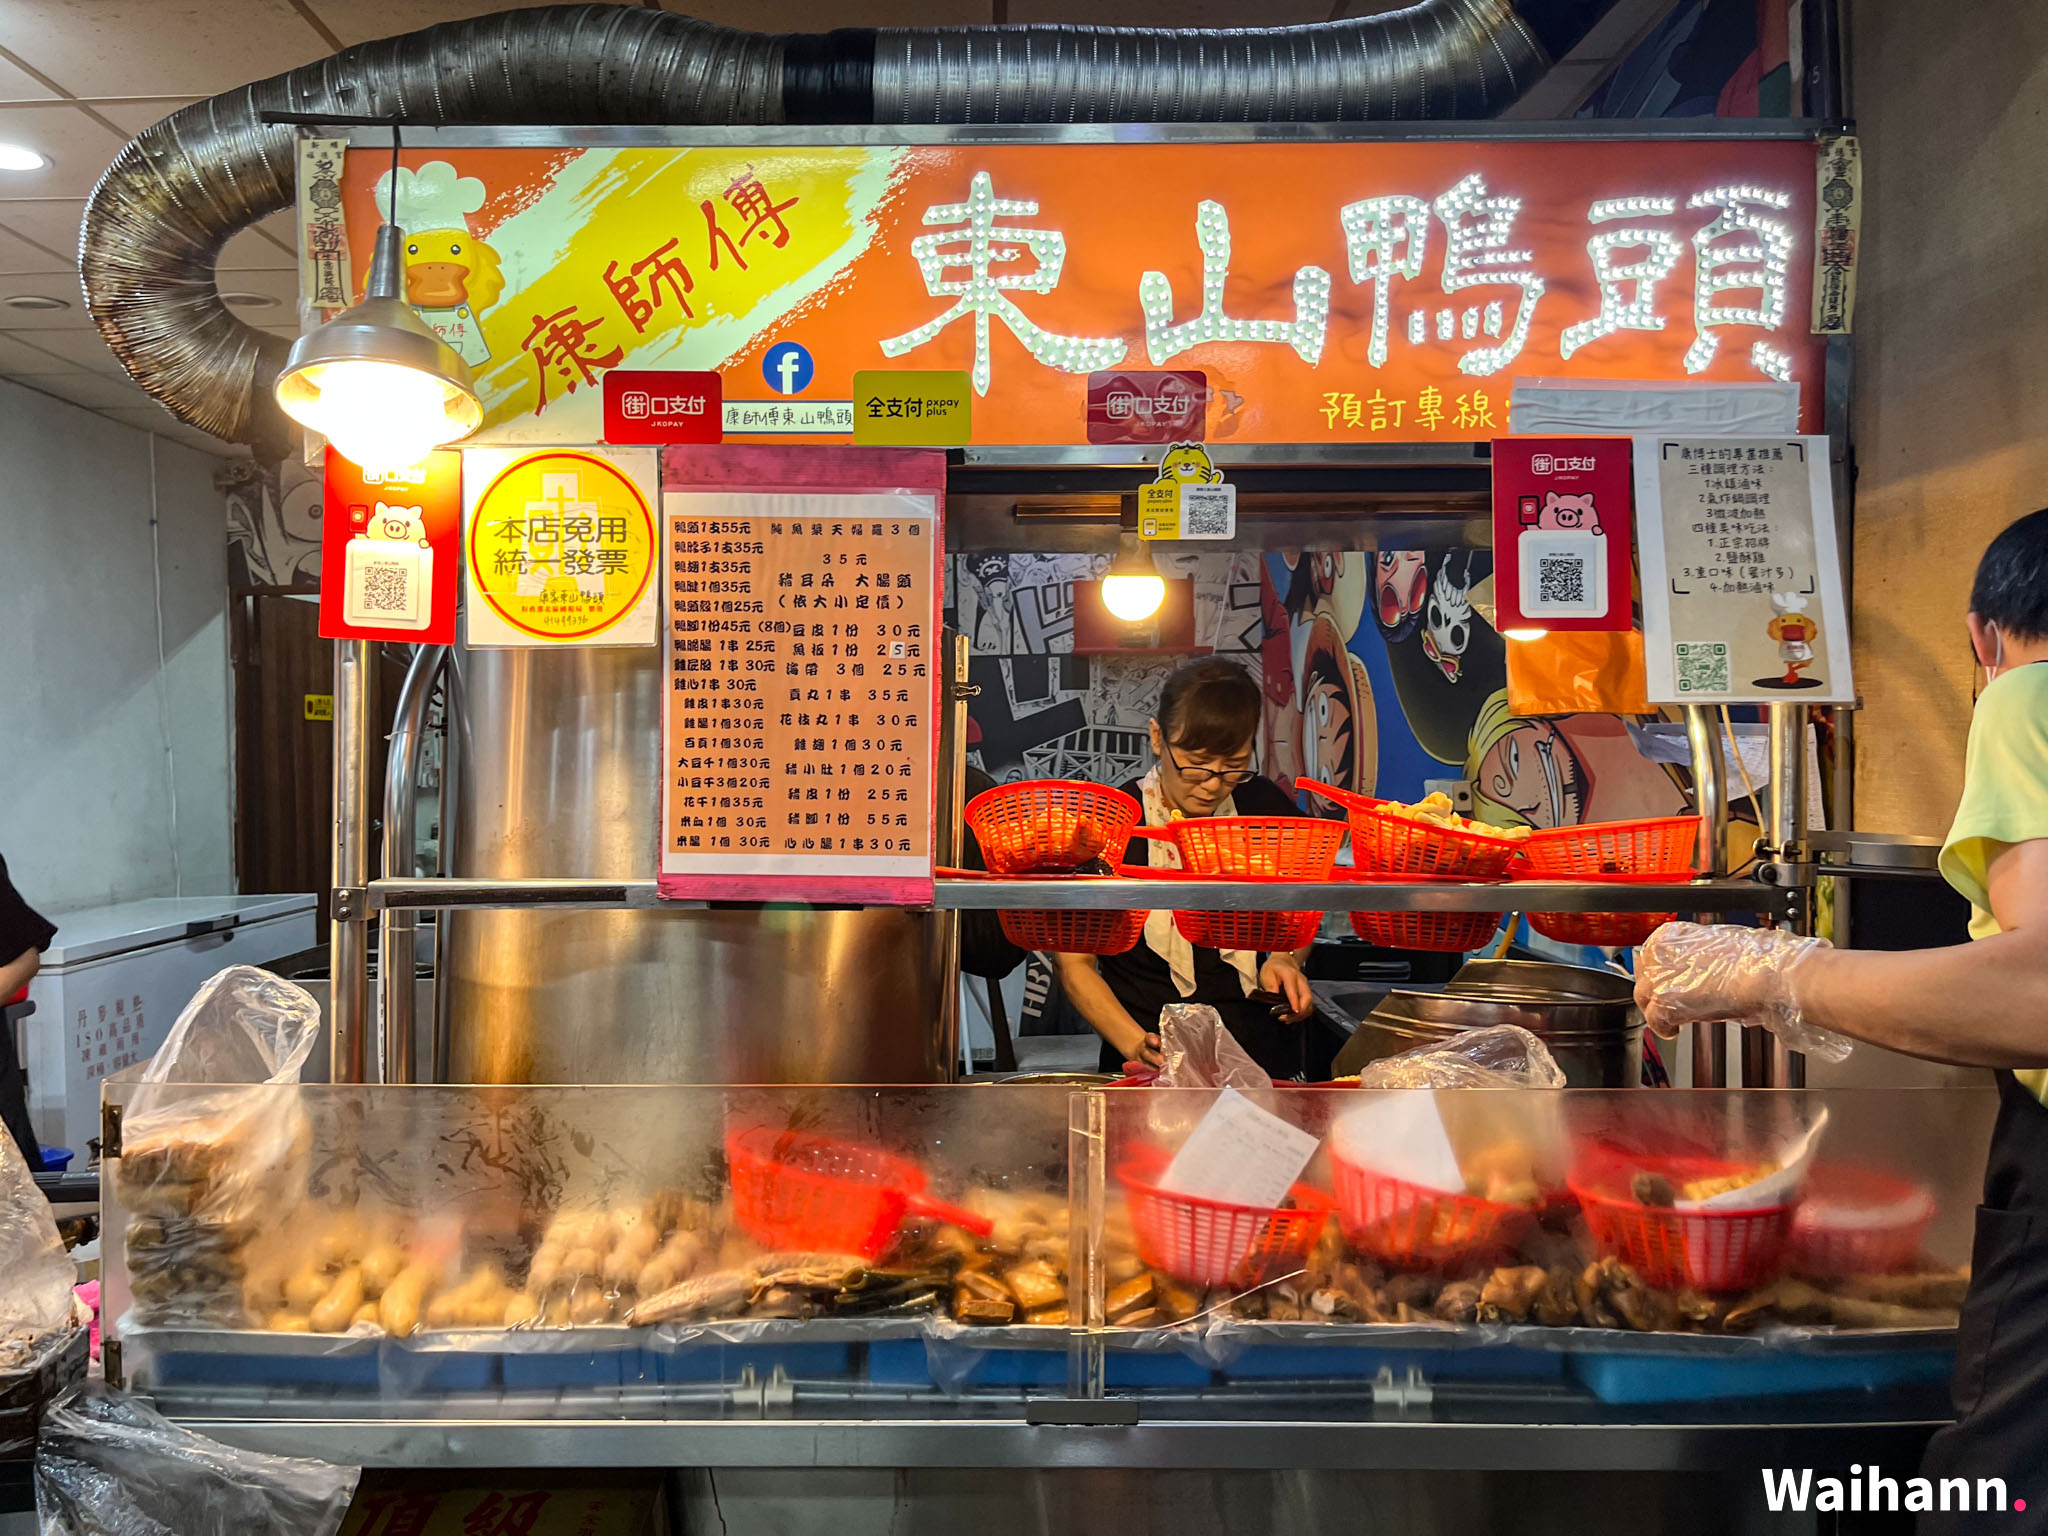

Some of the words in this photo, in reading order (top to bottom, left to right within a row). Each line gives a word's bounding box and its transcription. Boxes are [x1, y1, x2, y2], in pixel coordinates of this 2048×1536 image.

[521, 165, 800, 416] 康師傅
[879, 170, 1792, 398] 東山鴨頭
[622, 391, 706, 419] 街口支付
[865, 396, 924, 418] 全支付
[926, 397, 960, 410] pxpay
[926, 406, 948, 418] plus
[1107, 391, 1190, 419] 街口支付
[726, 406, 854, 427] 康師傅東山鴨頭
[1531, 453, 1596, 475] 街口支付
[1146, 488, 1174, 499] 全支付
[494, 516, 627, 544] 本店免用
[494, 548, 629, 576] 統一發票
